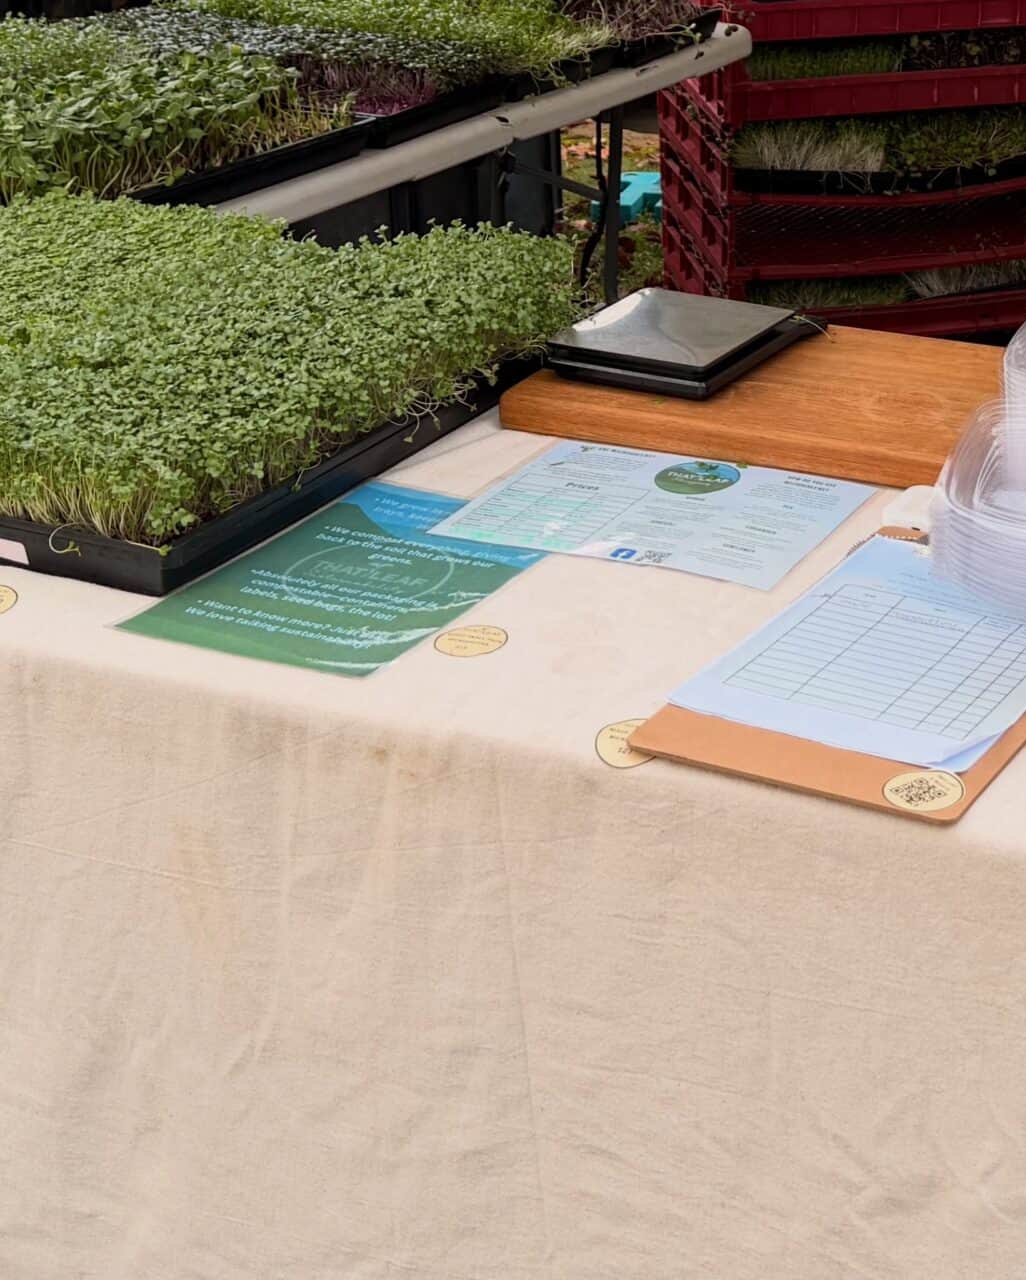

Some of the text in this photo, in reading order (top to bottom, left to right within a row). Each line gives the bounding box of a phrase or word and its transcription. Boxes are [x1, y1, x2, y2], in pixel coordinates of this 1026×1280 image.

[315, 532, 344, 543] back
[361, 540, 384, 550] the
[407, 549, 433, 559] that
[471, 559, 496, 569] our
[185, 607, 280, 631] We love talking
[204, 599, 332, 630] Want to know more?
